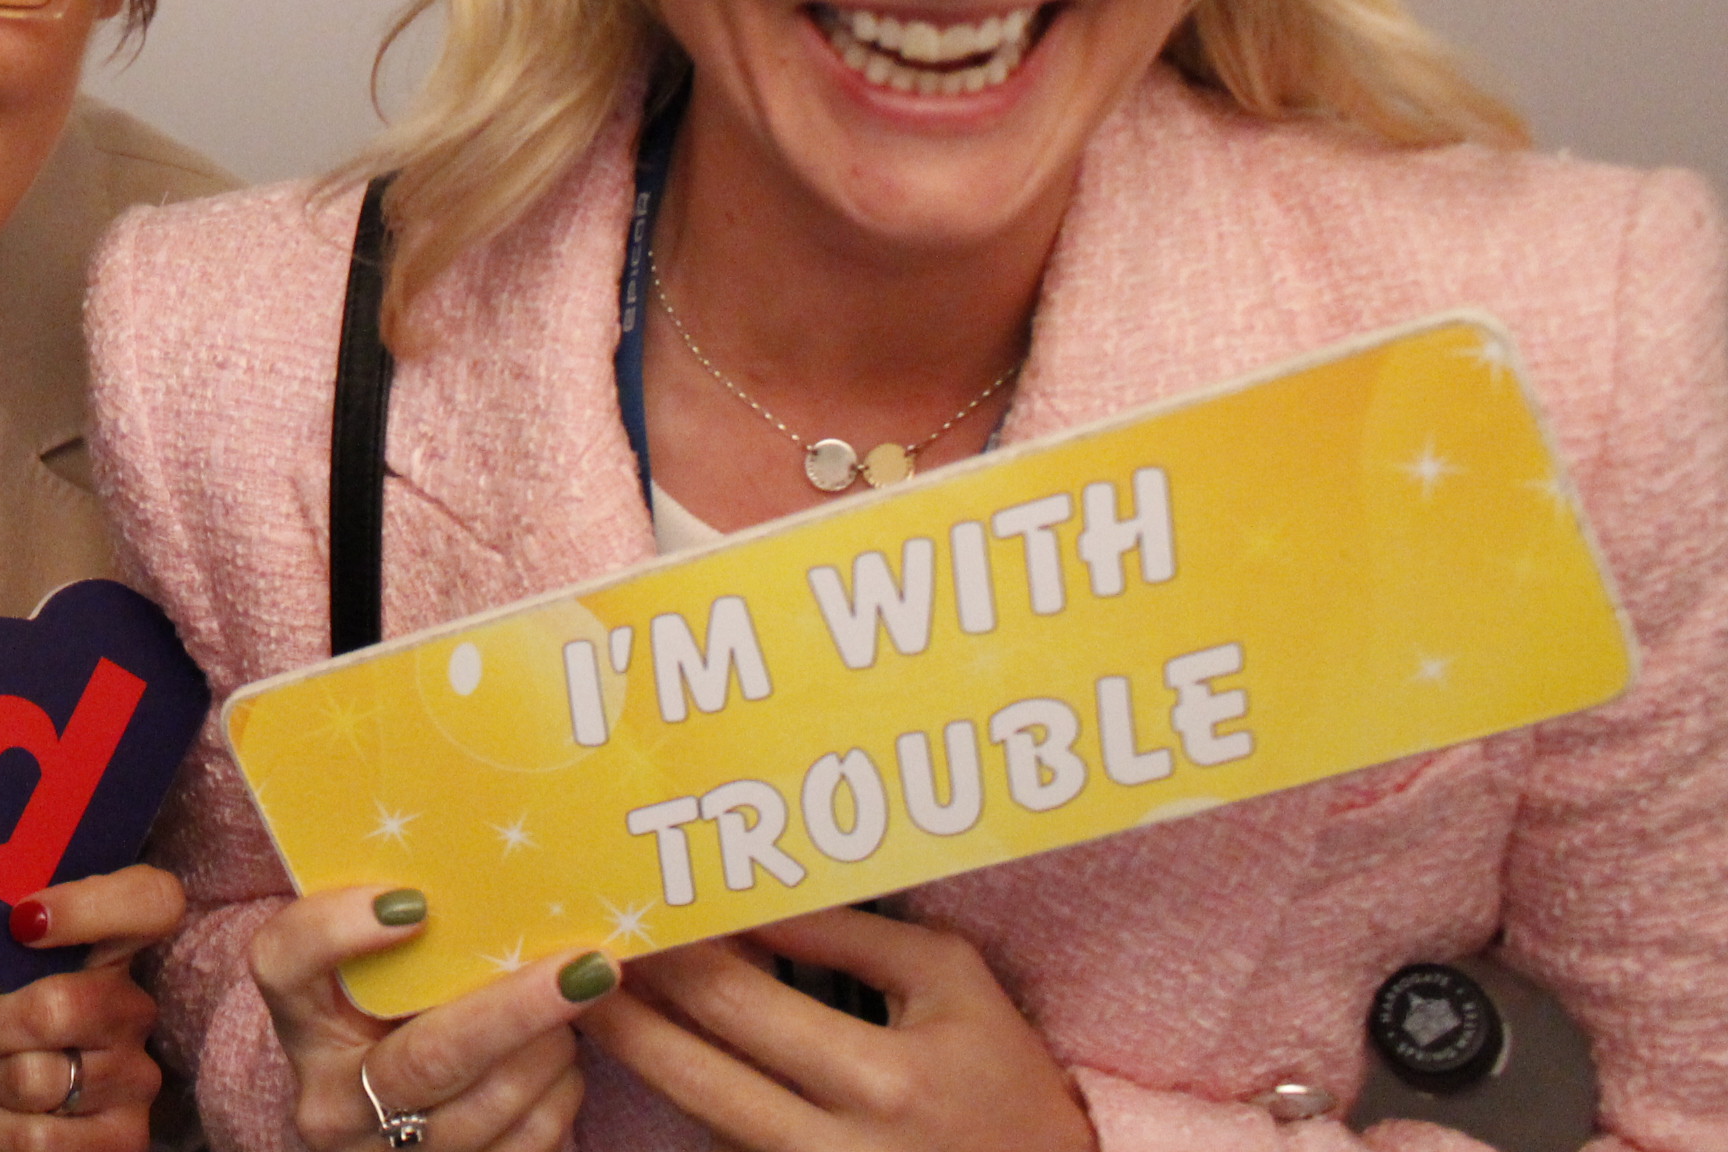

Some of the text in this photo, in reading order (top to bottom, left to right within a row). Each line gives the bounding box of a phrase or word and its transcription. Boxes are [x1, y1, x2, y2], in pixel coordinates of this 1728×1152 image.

[563, 466, 1175, 747] I'M WITH
[626, 642, 1254, 906] TROUBLE
